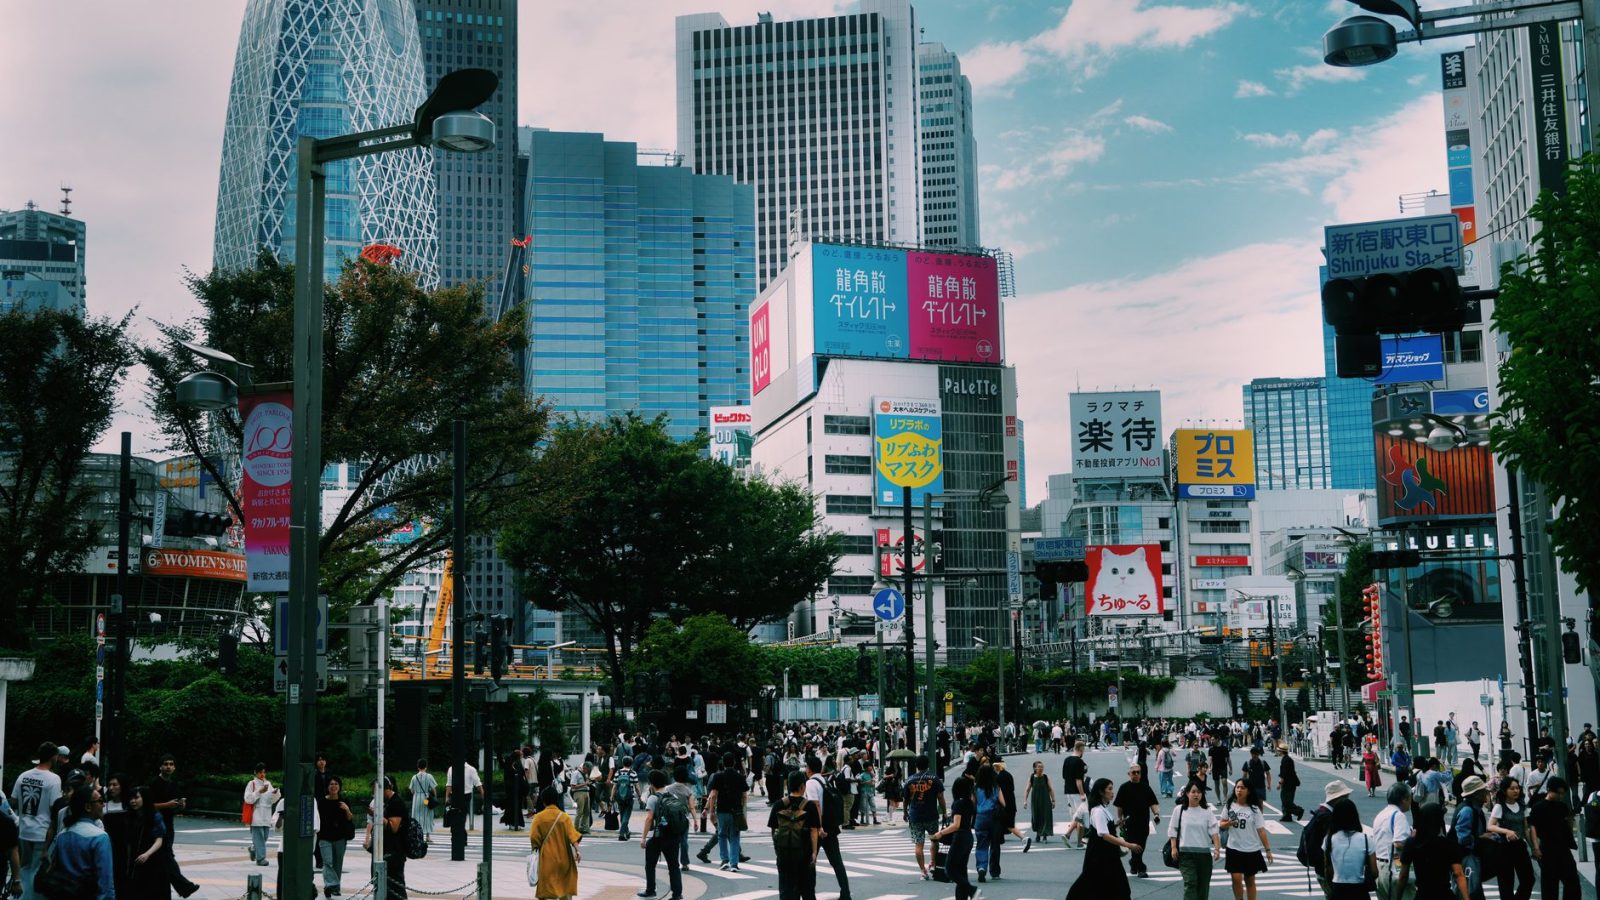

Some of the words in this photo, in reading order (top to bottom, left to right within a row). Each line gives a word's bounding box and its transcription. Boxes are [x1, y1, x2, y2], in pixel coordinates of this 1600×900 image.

[1539, 24, 1551, 67] SMBC
[1445, 54, 1462, 77] 羊
[1540, 73, 1560, 161] 三井住友銀行
[1331, 222, 1453, 255] 新宿駅東口
[1331, 254, 1399, 274] Shinjuku
[836, 267, 886, 294] 龍角散
[928, 274, 977, 300] 龍角散
[829, 294, 896, 320] ダイレクト
[922, 301, 987, 326] ダイレクト
[753, 314, 767, 349] UNI
[754, 348, 769, 387] QLO
[945, 378, 998, 396] PaLeTTe
[1087, 401, 1145, 412] ラクマチ
[1078, 417, 1156, 453] 楽待
[1194, 433, 1235, 455] プロ
[886, 442, 935, 458] リブふわ
[885, 460, 935, 479] マスク
[1196, 458, 1236, 478] ミス
[1199, 486, 1226, 495] プロミス
[1036, 539, 1083, 550] 新宿駅東口
[163, 553, 226, 570] WOMEN'S
[1279, 603, 1292, 611] EN
